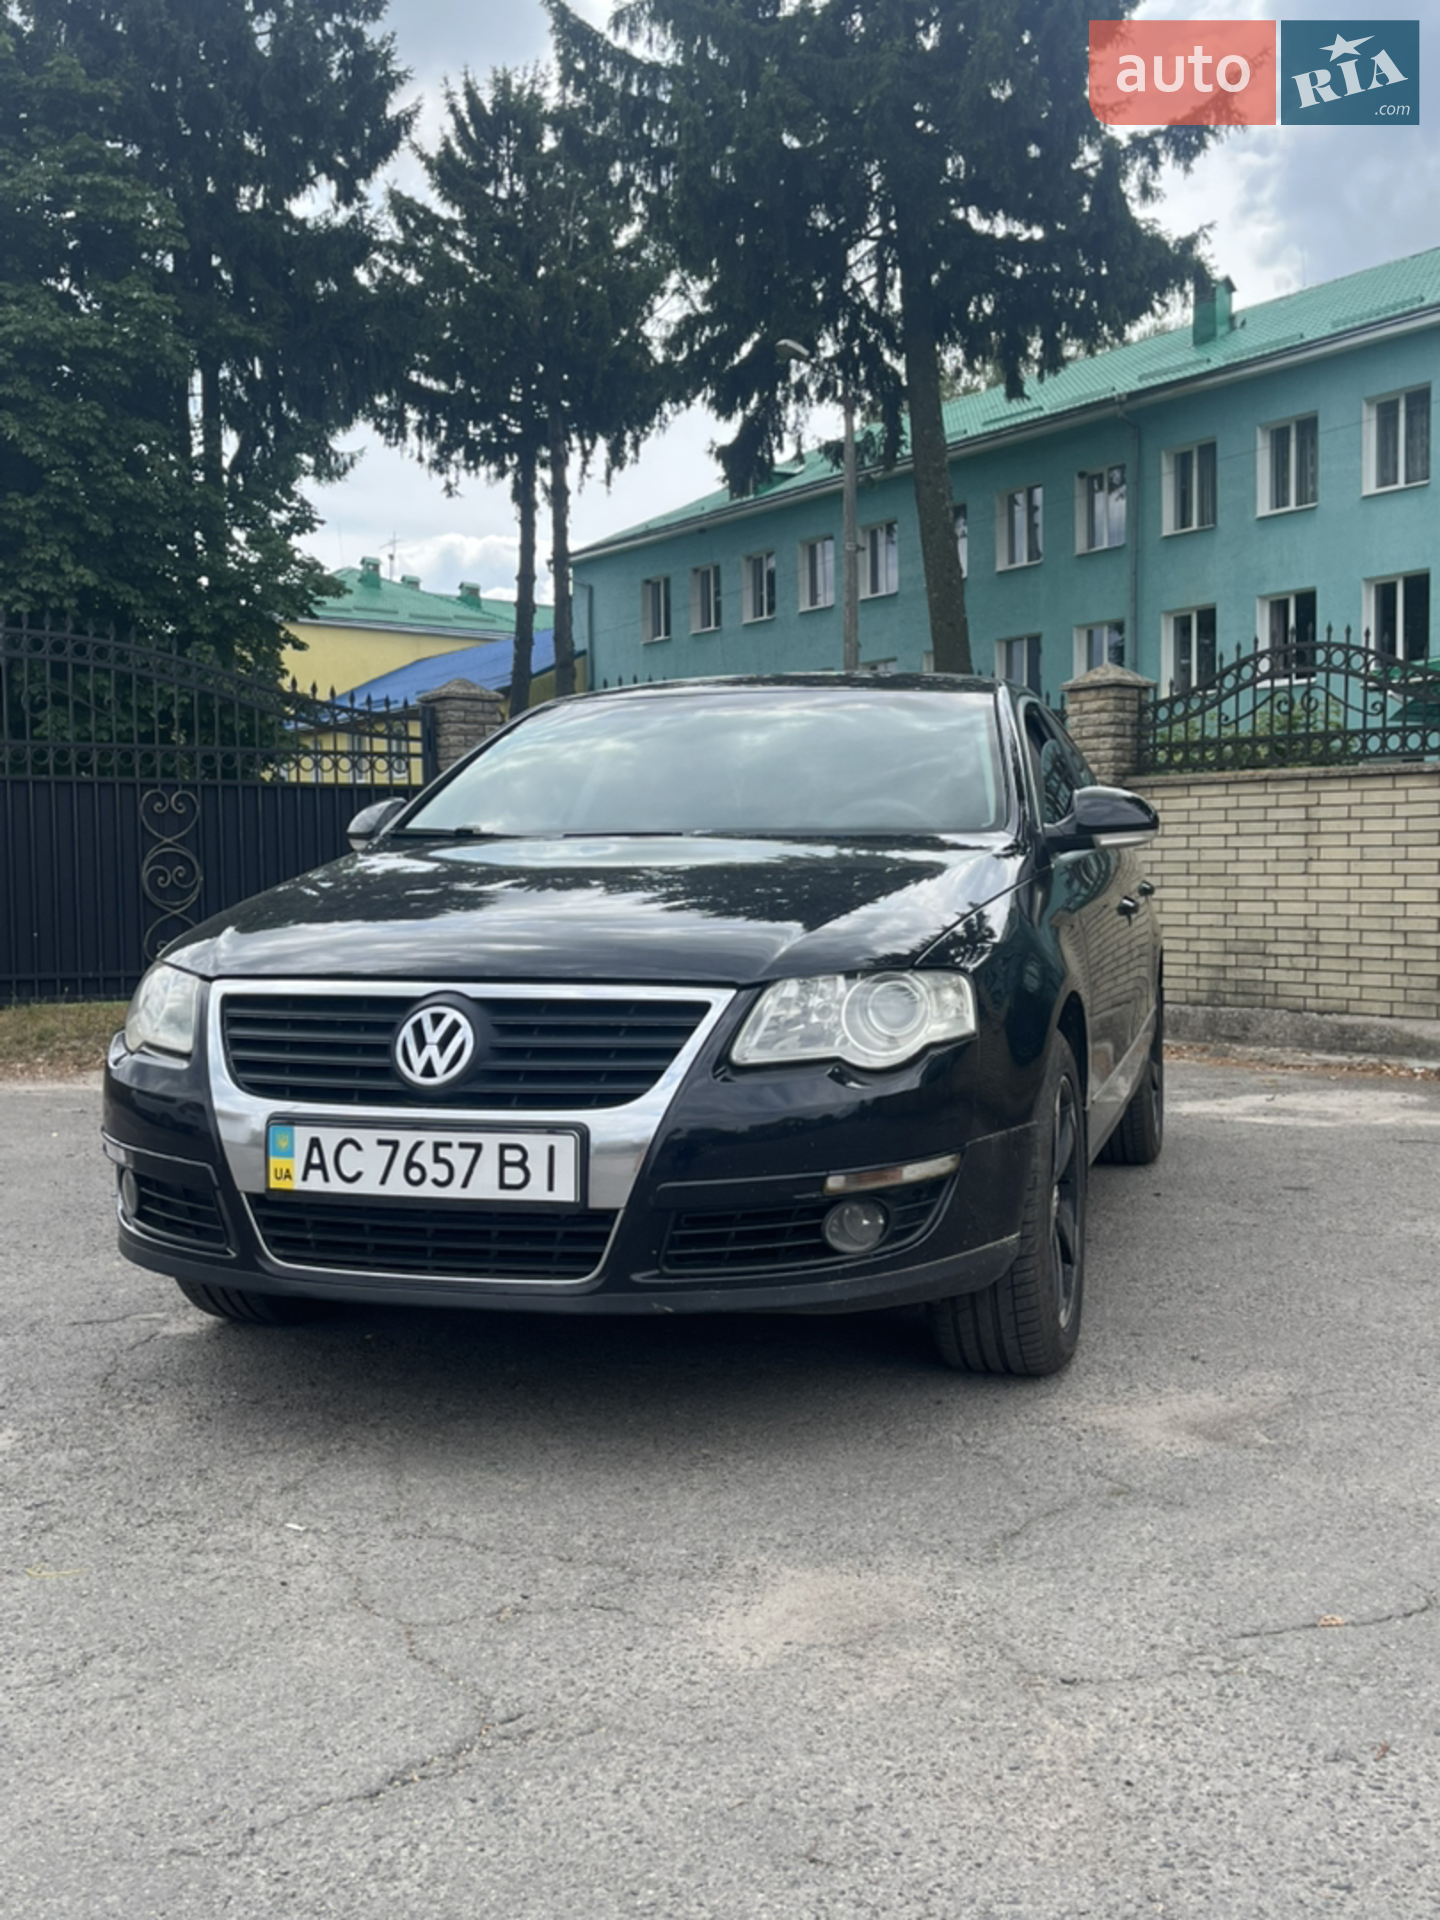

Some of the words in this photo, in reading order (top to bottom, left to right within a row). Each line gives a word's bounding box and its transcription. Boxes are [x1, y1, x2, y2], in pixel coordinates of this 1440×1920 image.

[274, 1167, 292, 1181] UA
[301, 1136, 364, 1184] AC
[376, 1139, 483, 1189] 7657
[498, 1143, 555, 1192] BI
